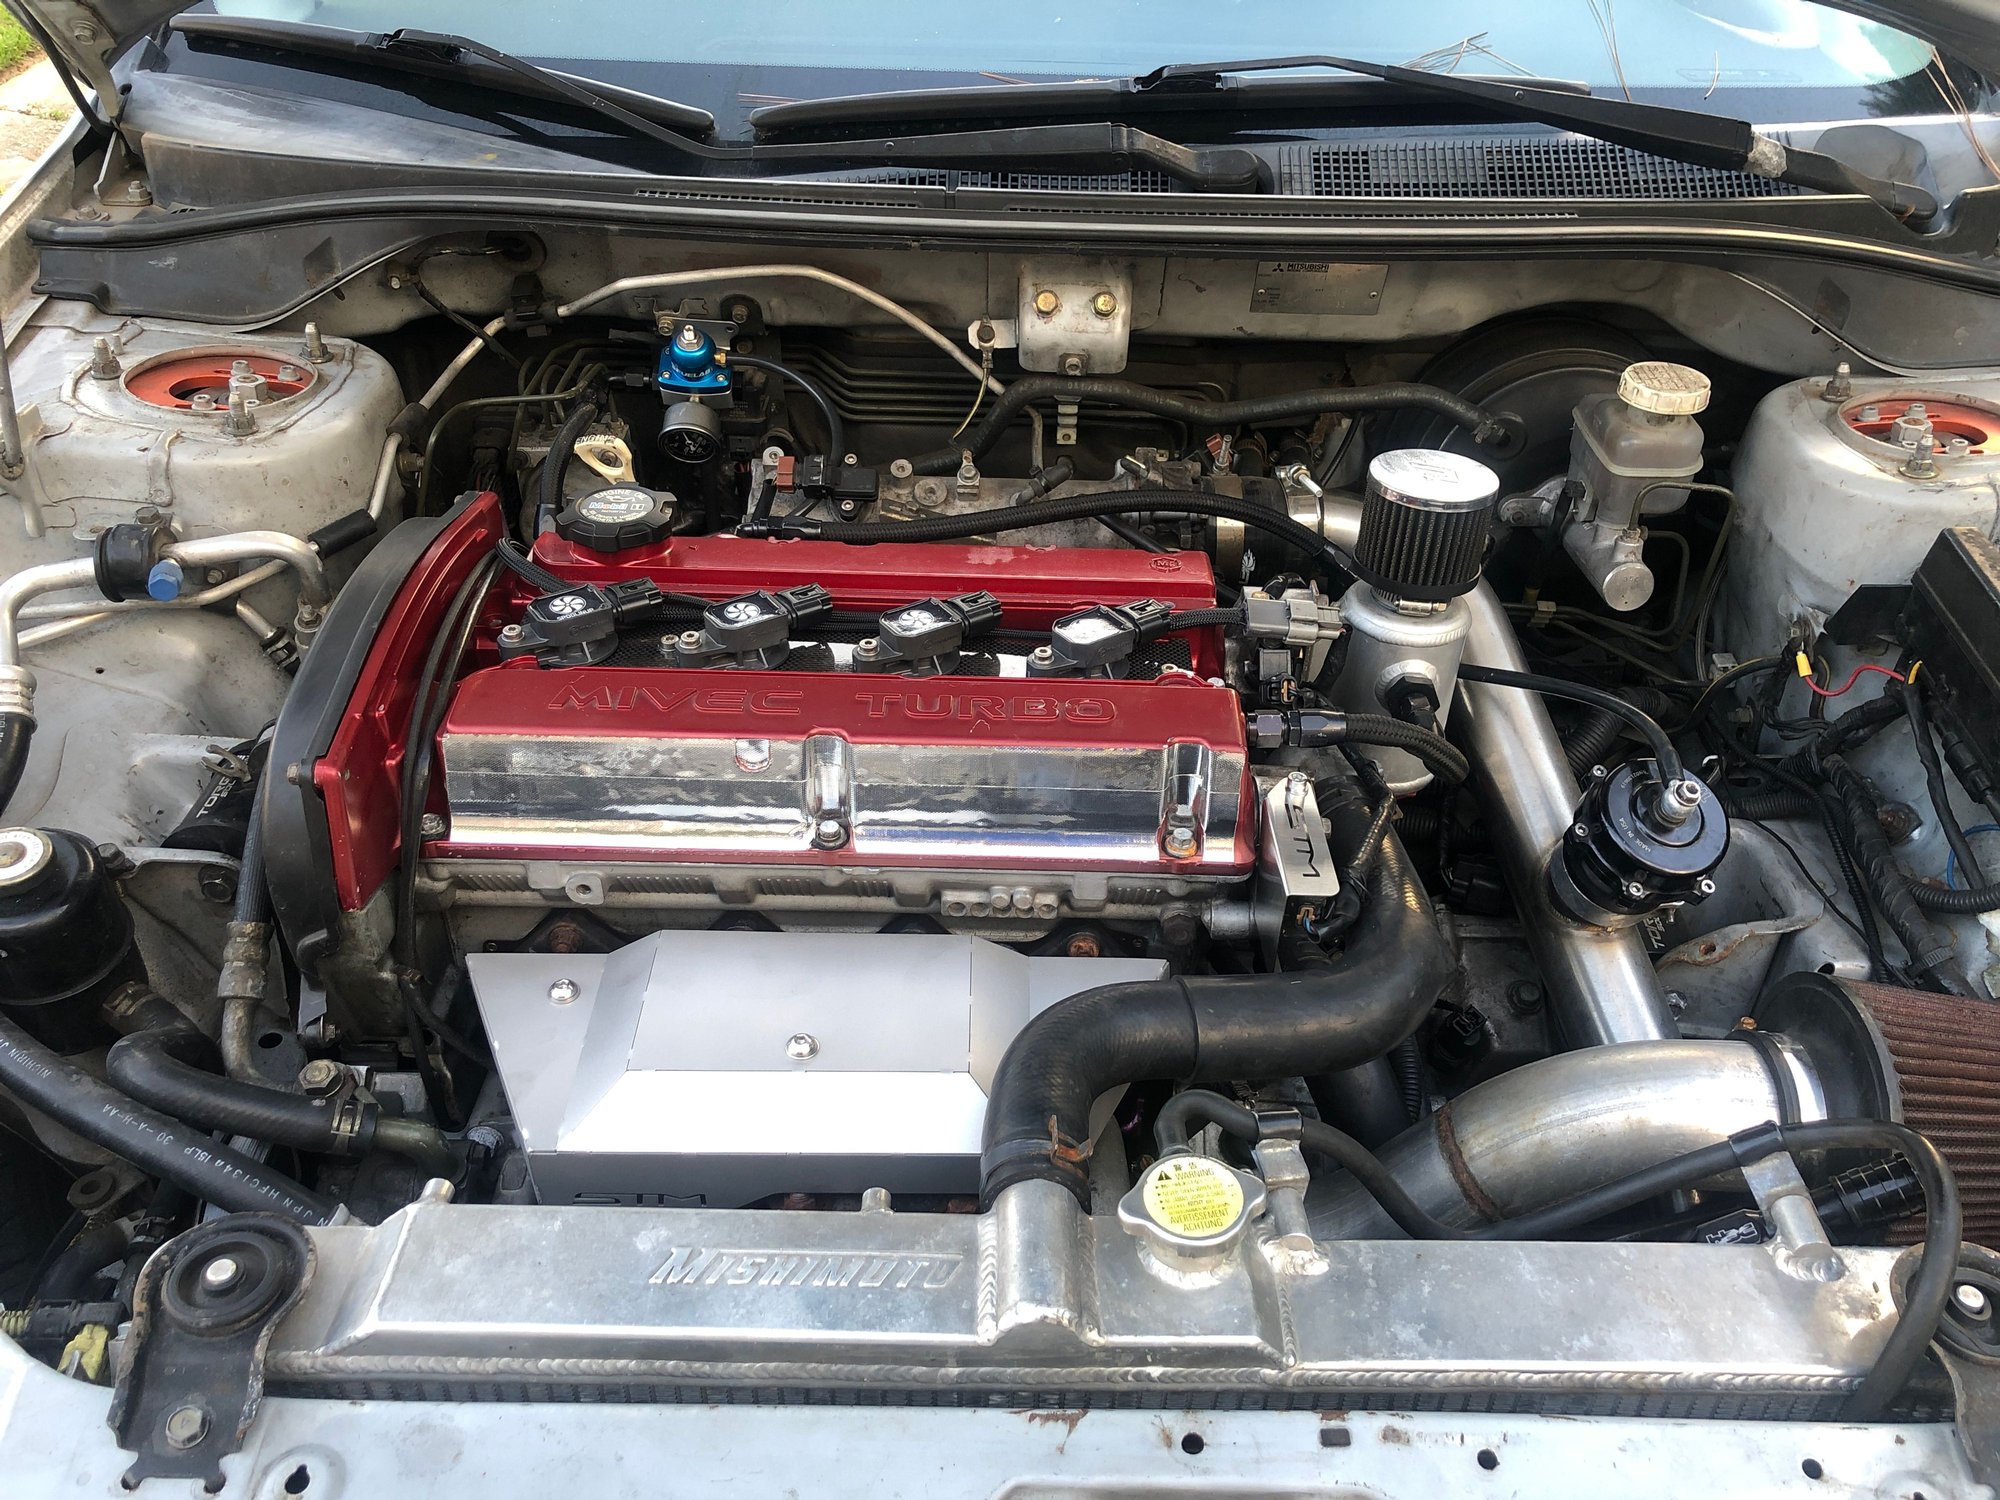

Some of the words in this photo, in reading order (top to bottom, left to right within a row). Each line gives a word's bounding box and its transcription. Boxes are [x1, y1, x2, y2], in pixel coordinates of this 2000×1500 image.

[593, 489, 631, 499] ENGINE
[588, 501, 628, 510] Mobil
[548, 685, 803, 715] MIVEC
[855, 693, 1118, 723] TURBO
[1618, 818, 1629, 830] USA
[1635, 837, 1651, 852] MADE
[1175, 1168, 1214, 1180] WARNING
[283, 1197, 314, 1218] JPN
[1170, 1208, 1229, 1224] AVERTISSEMENT
[1183, 1218, 1224, 1232] ACHTUNG
[649, 1246, 964, 1288] MISHIMOTO
